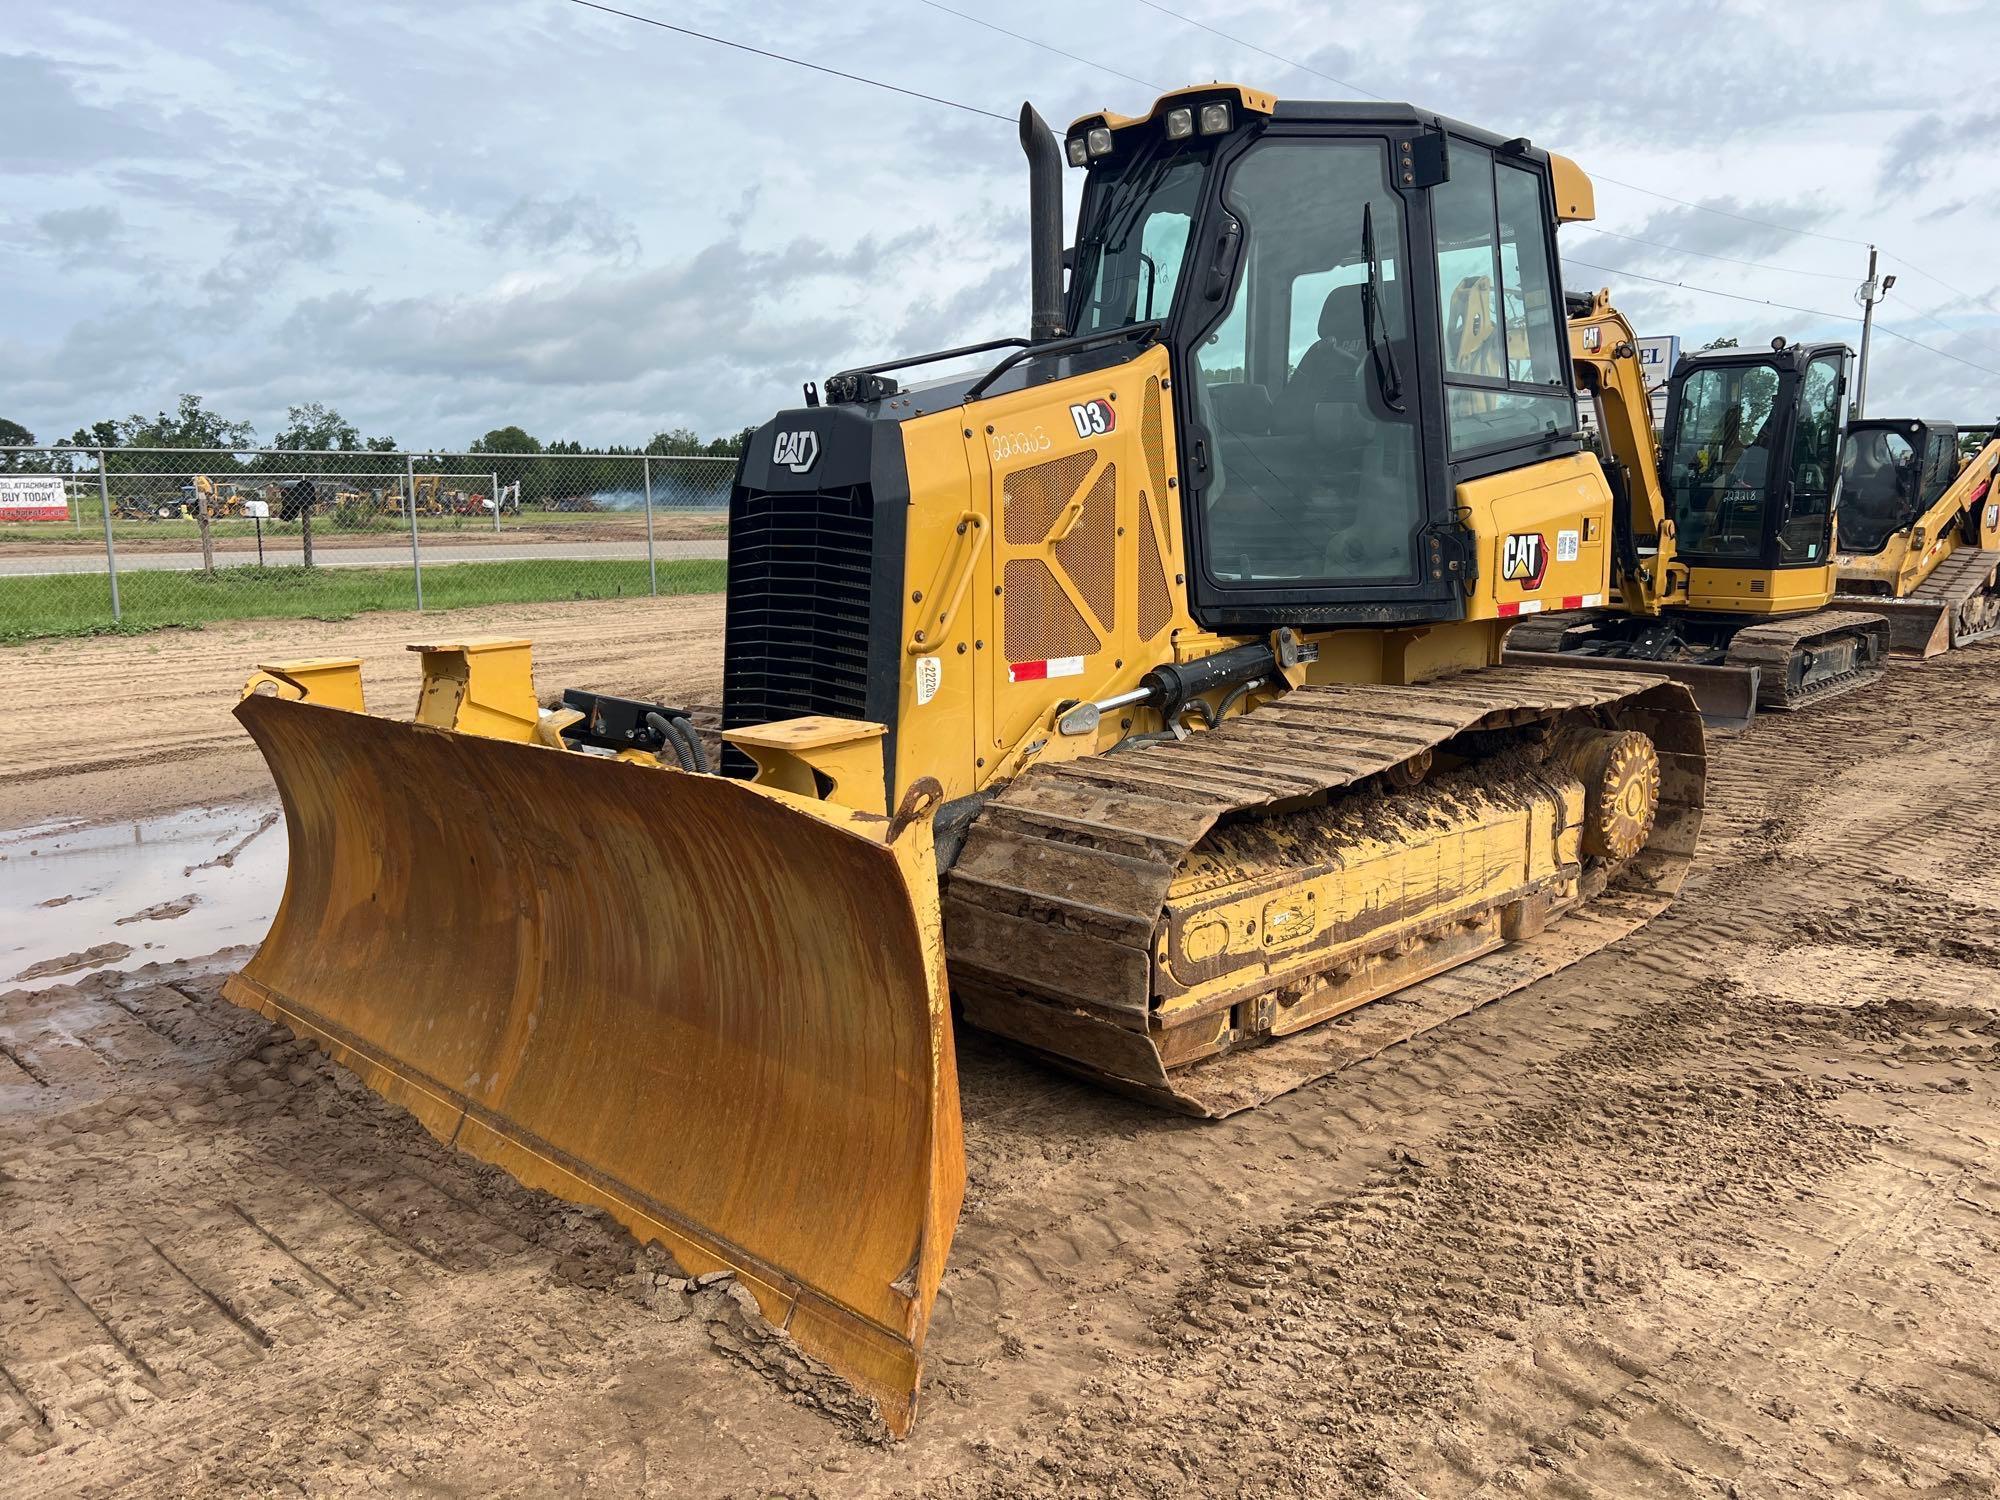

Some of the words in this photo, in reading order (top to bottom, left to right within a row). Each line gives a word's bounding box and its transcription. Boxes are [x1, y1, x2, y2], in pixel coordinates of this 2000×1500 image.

[1583, 327, 1599, 350] CAT
[1070, 401, 1106, 438] D3
[772, 431, 810, 464] CAT
[992, 425, 1051, 461] 222203
[2, 492, 20, 502] BUY
[23, 492, 56, 502] TODAY!
[1723, 489, 1757, 503] 222218
[1502, 534, 1539, 579] CAT
